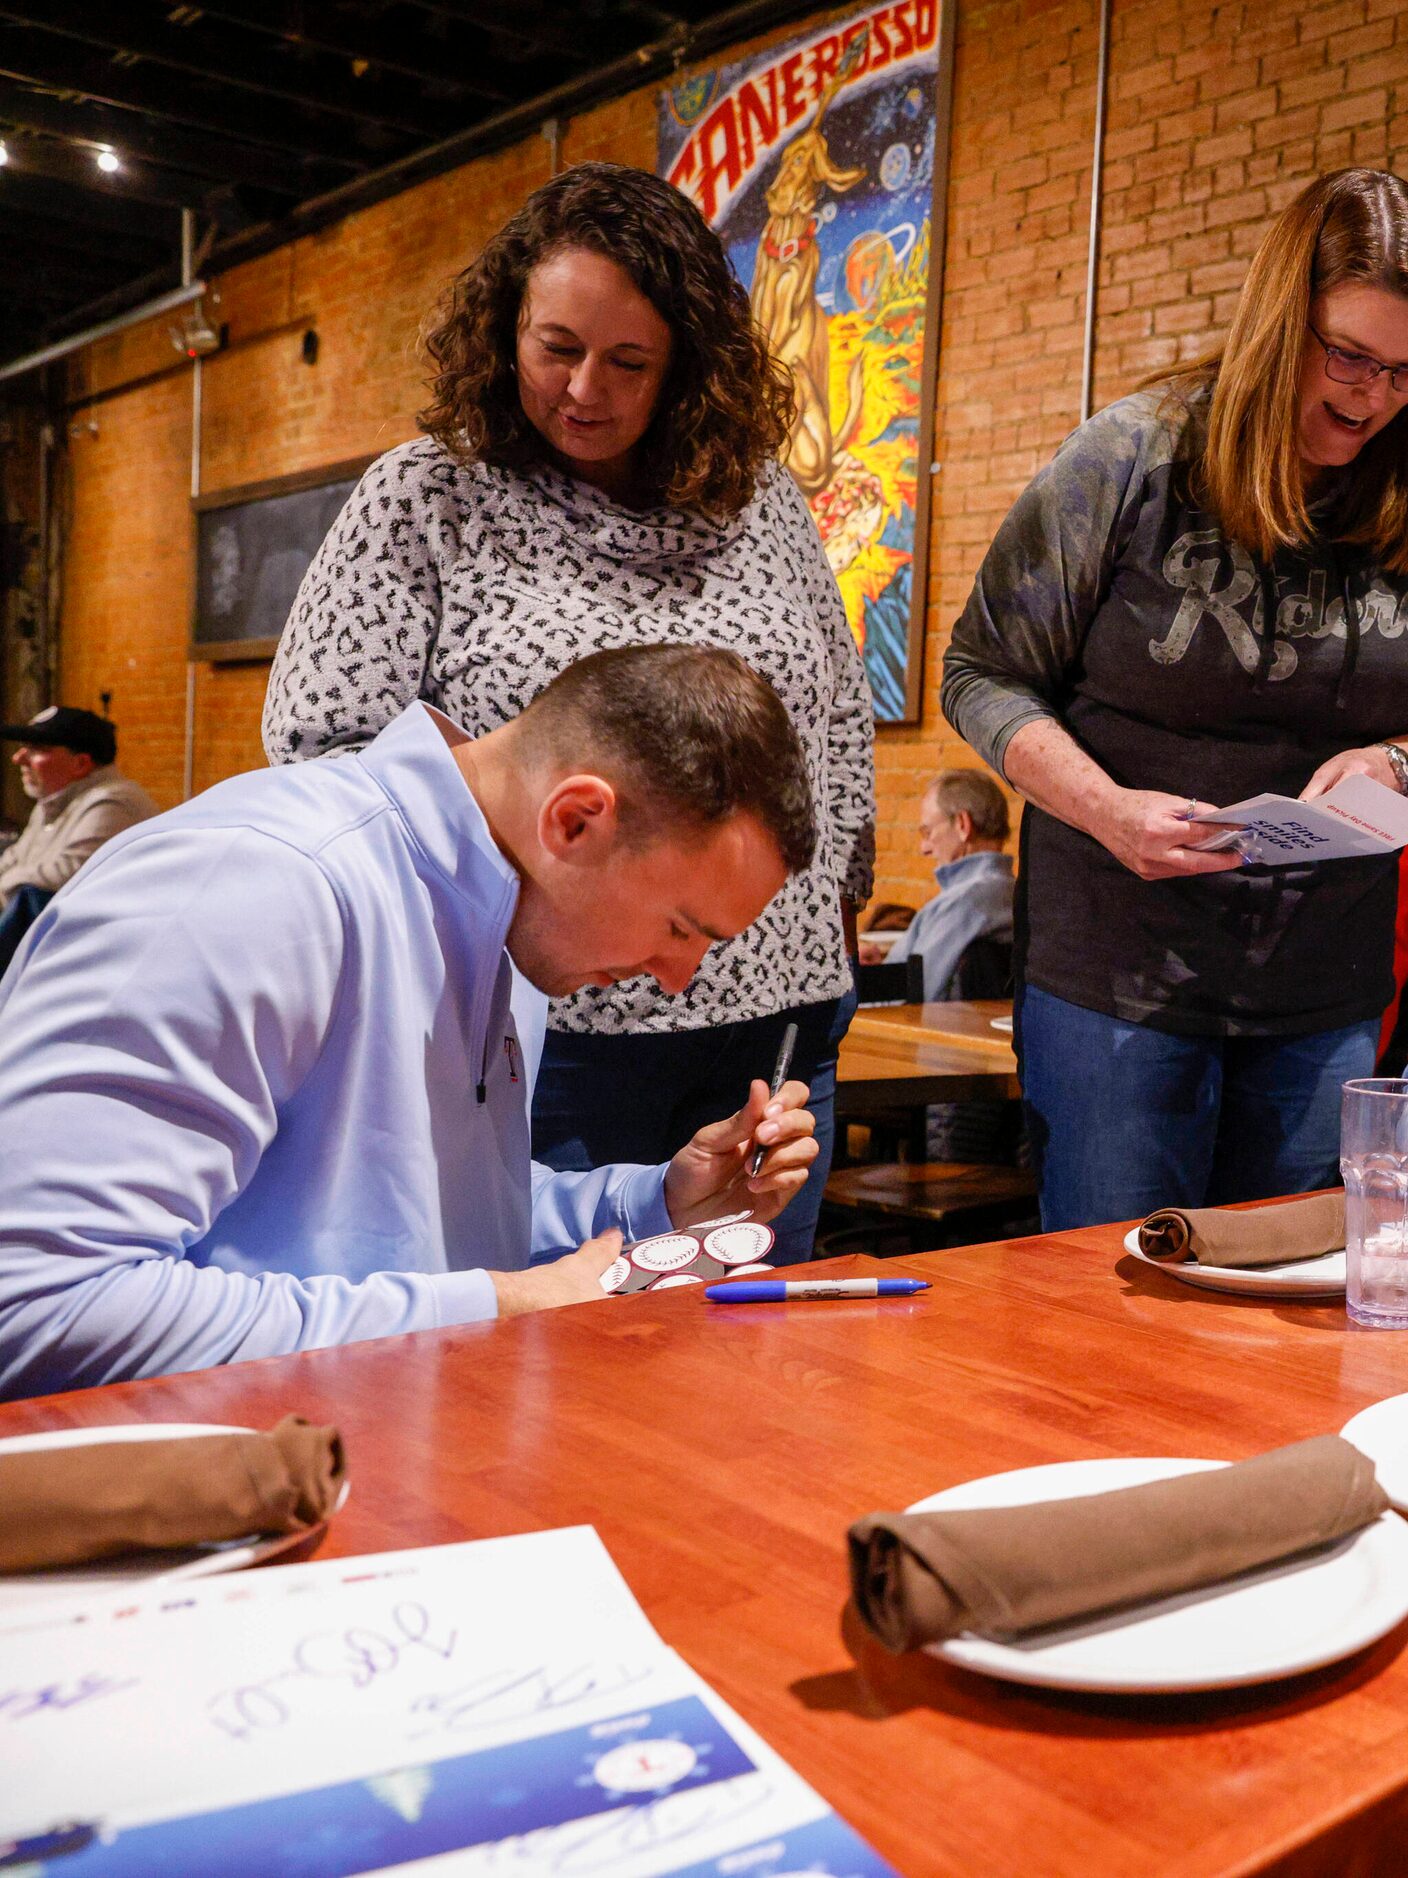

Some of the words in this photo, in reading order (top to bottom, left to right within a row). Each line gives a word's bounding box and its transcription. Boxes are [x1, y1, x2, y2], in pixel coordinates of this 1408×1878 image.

[1327, 805, 1350, 818] Pickup
[1243, 823, 1294, 850] nside
[1253, 820, 1315, 849] smiles
[1282, 820, 1330, 843] Find
[504, 1036, 519, 1084] T
